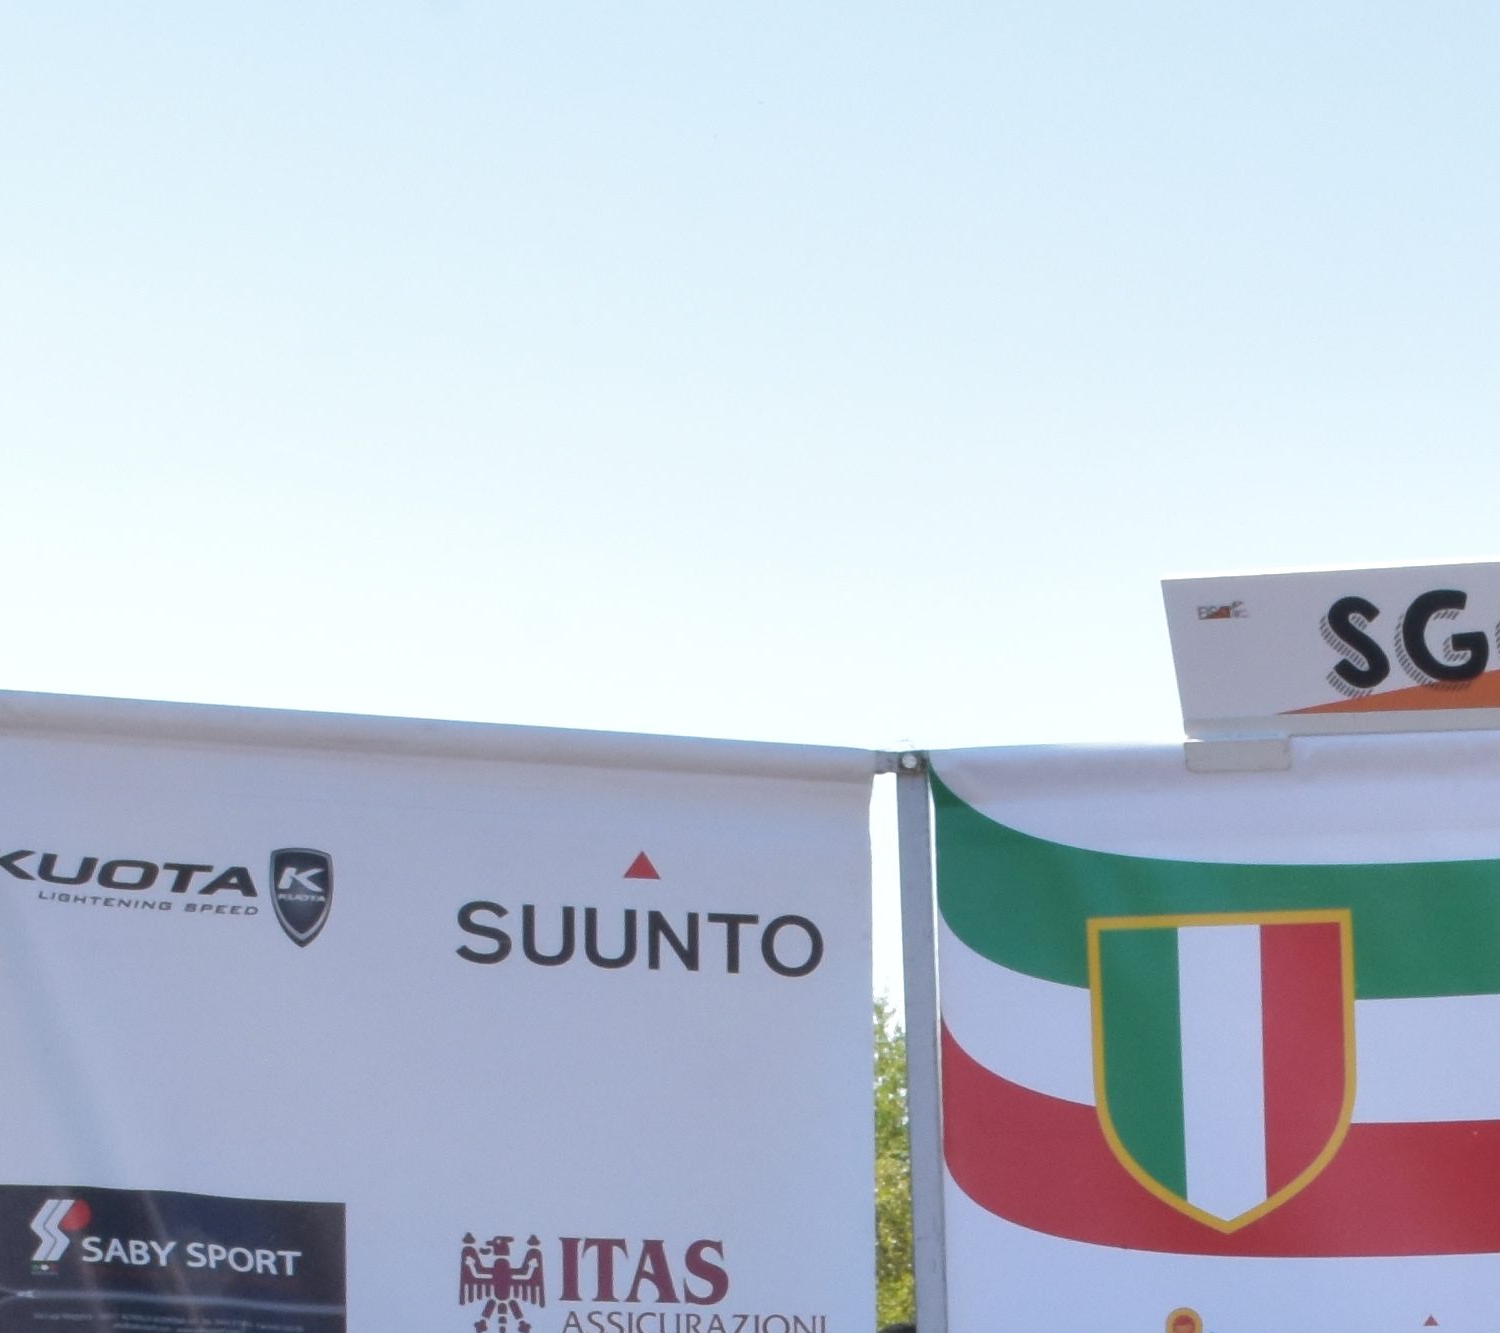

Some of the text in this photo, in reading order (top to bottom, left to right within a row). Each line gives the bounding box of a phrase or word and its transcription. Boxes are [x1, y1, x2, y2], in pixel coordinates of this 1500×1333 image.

[38, 890, 259, 916] LIGHTENING SPEED
[455, 899, 825, 979] SUUNTO
[82, 1237, 303, 1276] SABY SPORT
[558, 1236, 729, 1306] ITAS
